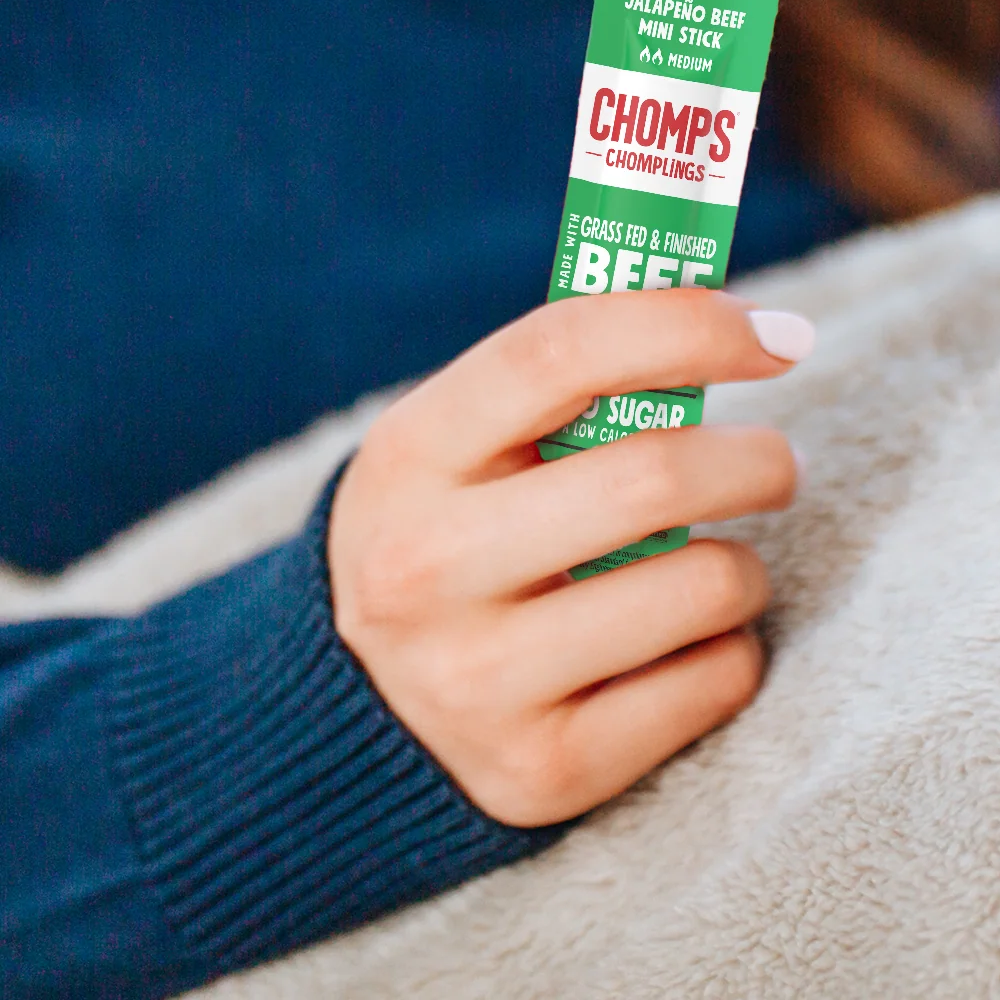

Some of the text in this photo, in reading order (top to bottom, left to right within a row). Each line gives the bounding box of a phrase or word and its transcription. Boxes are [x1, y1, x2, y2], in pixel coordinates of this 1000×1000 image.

[638, 18, 723, 49] MINI STICK
[710, 7, 746, 29] BEEF
[668, 52, 713, 72] MEDIUM
[589, 87, 736, 163] CHOMPS
[558, 213, 580, 288] MADE WITH
[580, 215, 717, 259] GRASS FED & FINISHED
[606, 395, 685, 430] SUGAR
[573, 422, 597, 440] LOW
